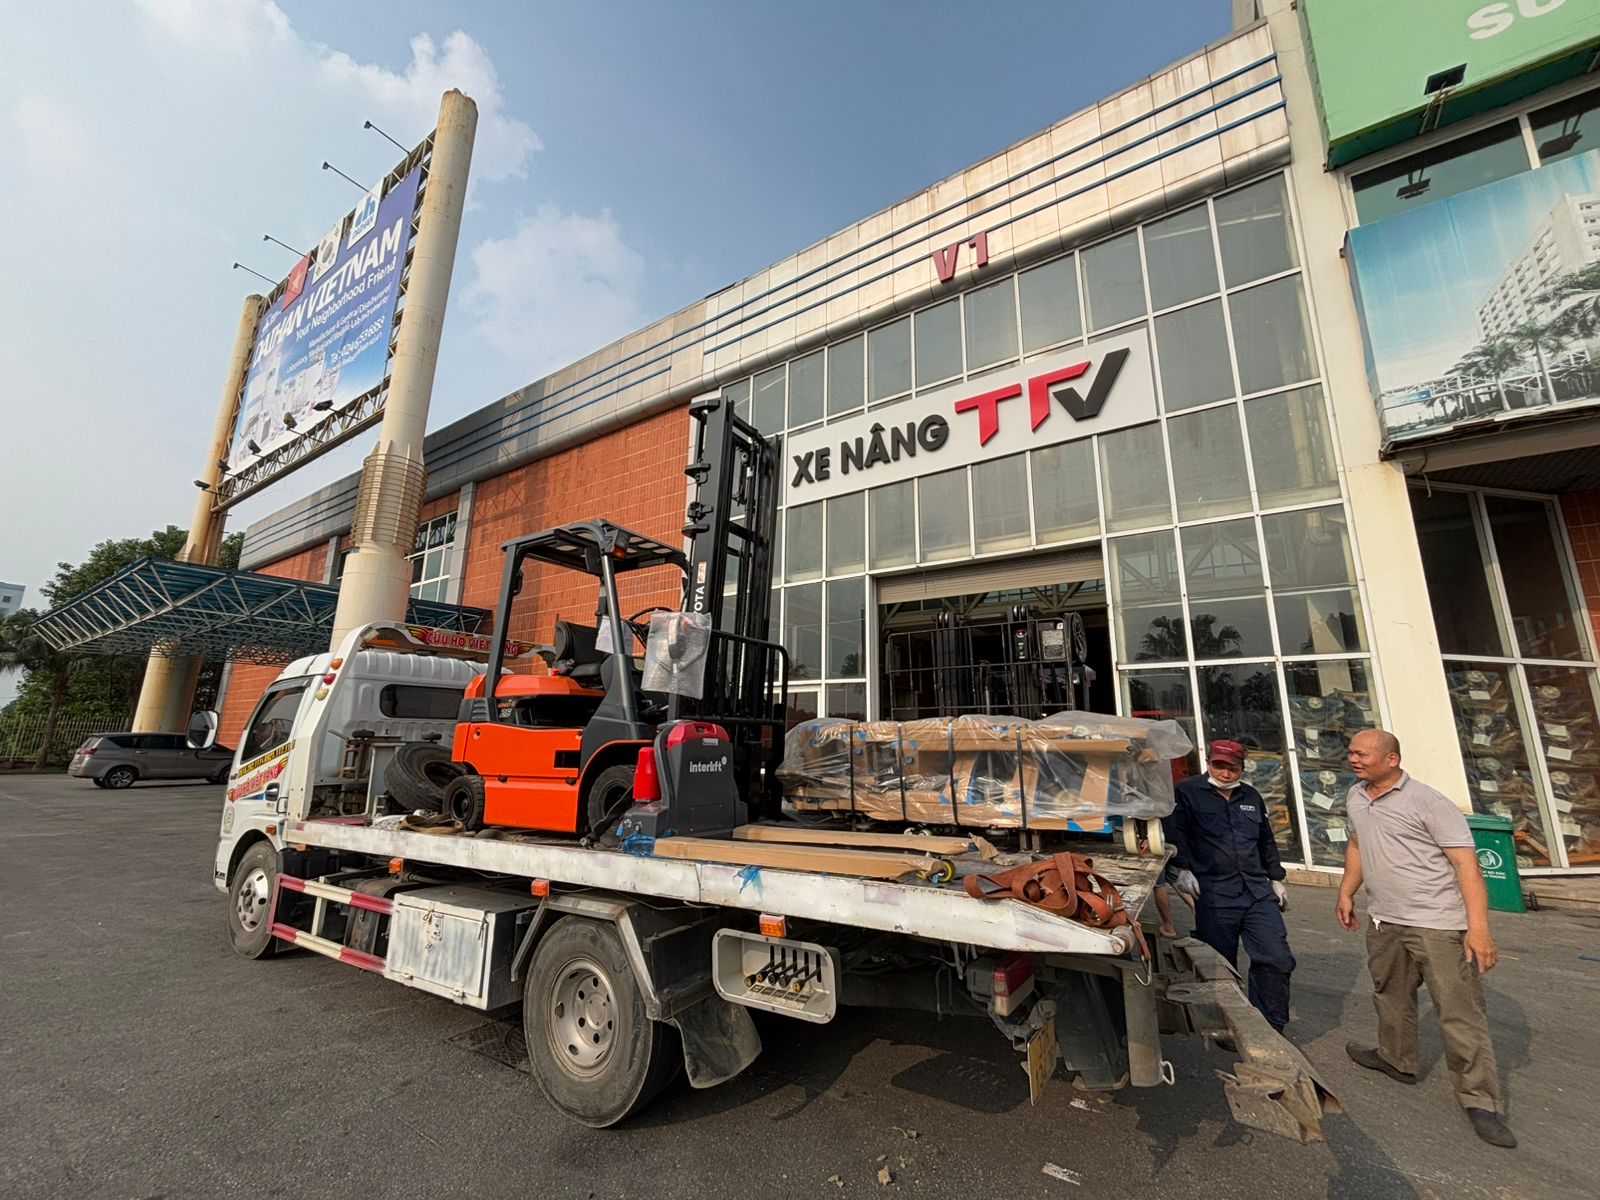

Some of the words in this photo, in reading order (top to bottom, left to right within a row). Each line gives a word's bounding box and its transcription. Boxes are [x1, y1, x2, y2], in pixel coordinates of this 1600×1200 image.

[252, 298, 309, 368] DAIHAN
[307, 217, 404, 319] VIETNAM
[296, 322, 311, 341] Your
[311, 278, 366, 330] Neighborhood
[366, 256, 397, 289] Friend
[932, 231, 988, 284] V1
[791, 446, 831, 488] XE
[841, 414, 949, 475] NÂNG
[954, 347, 1130, 447] TTV
[689, 760, 722, 773] interlift
